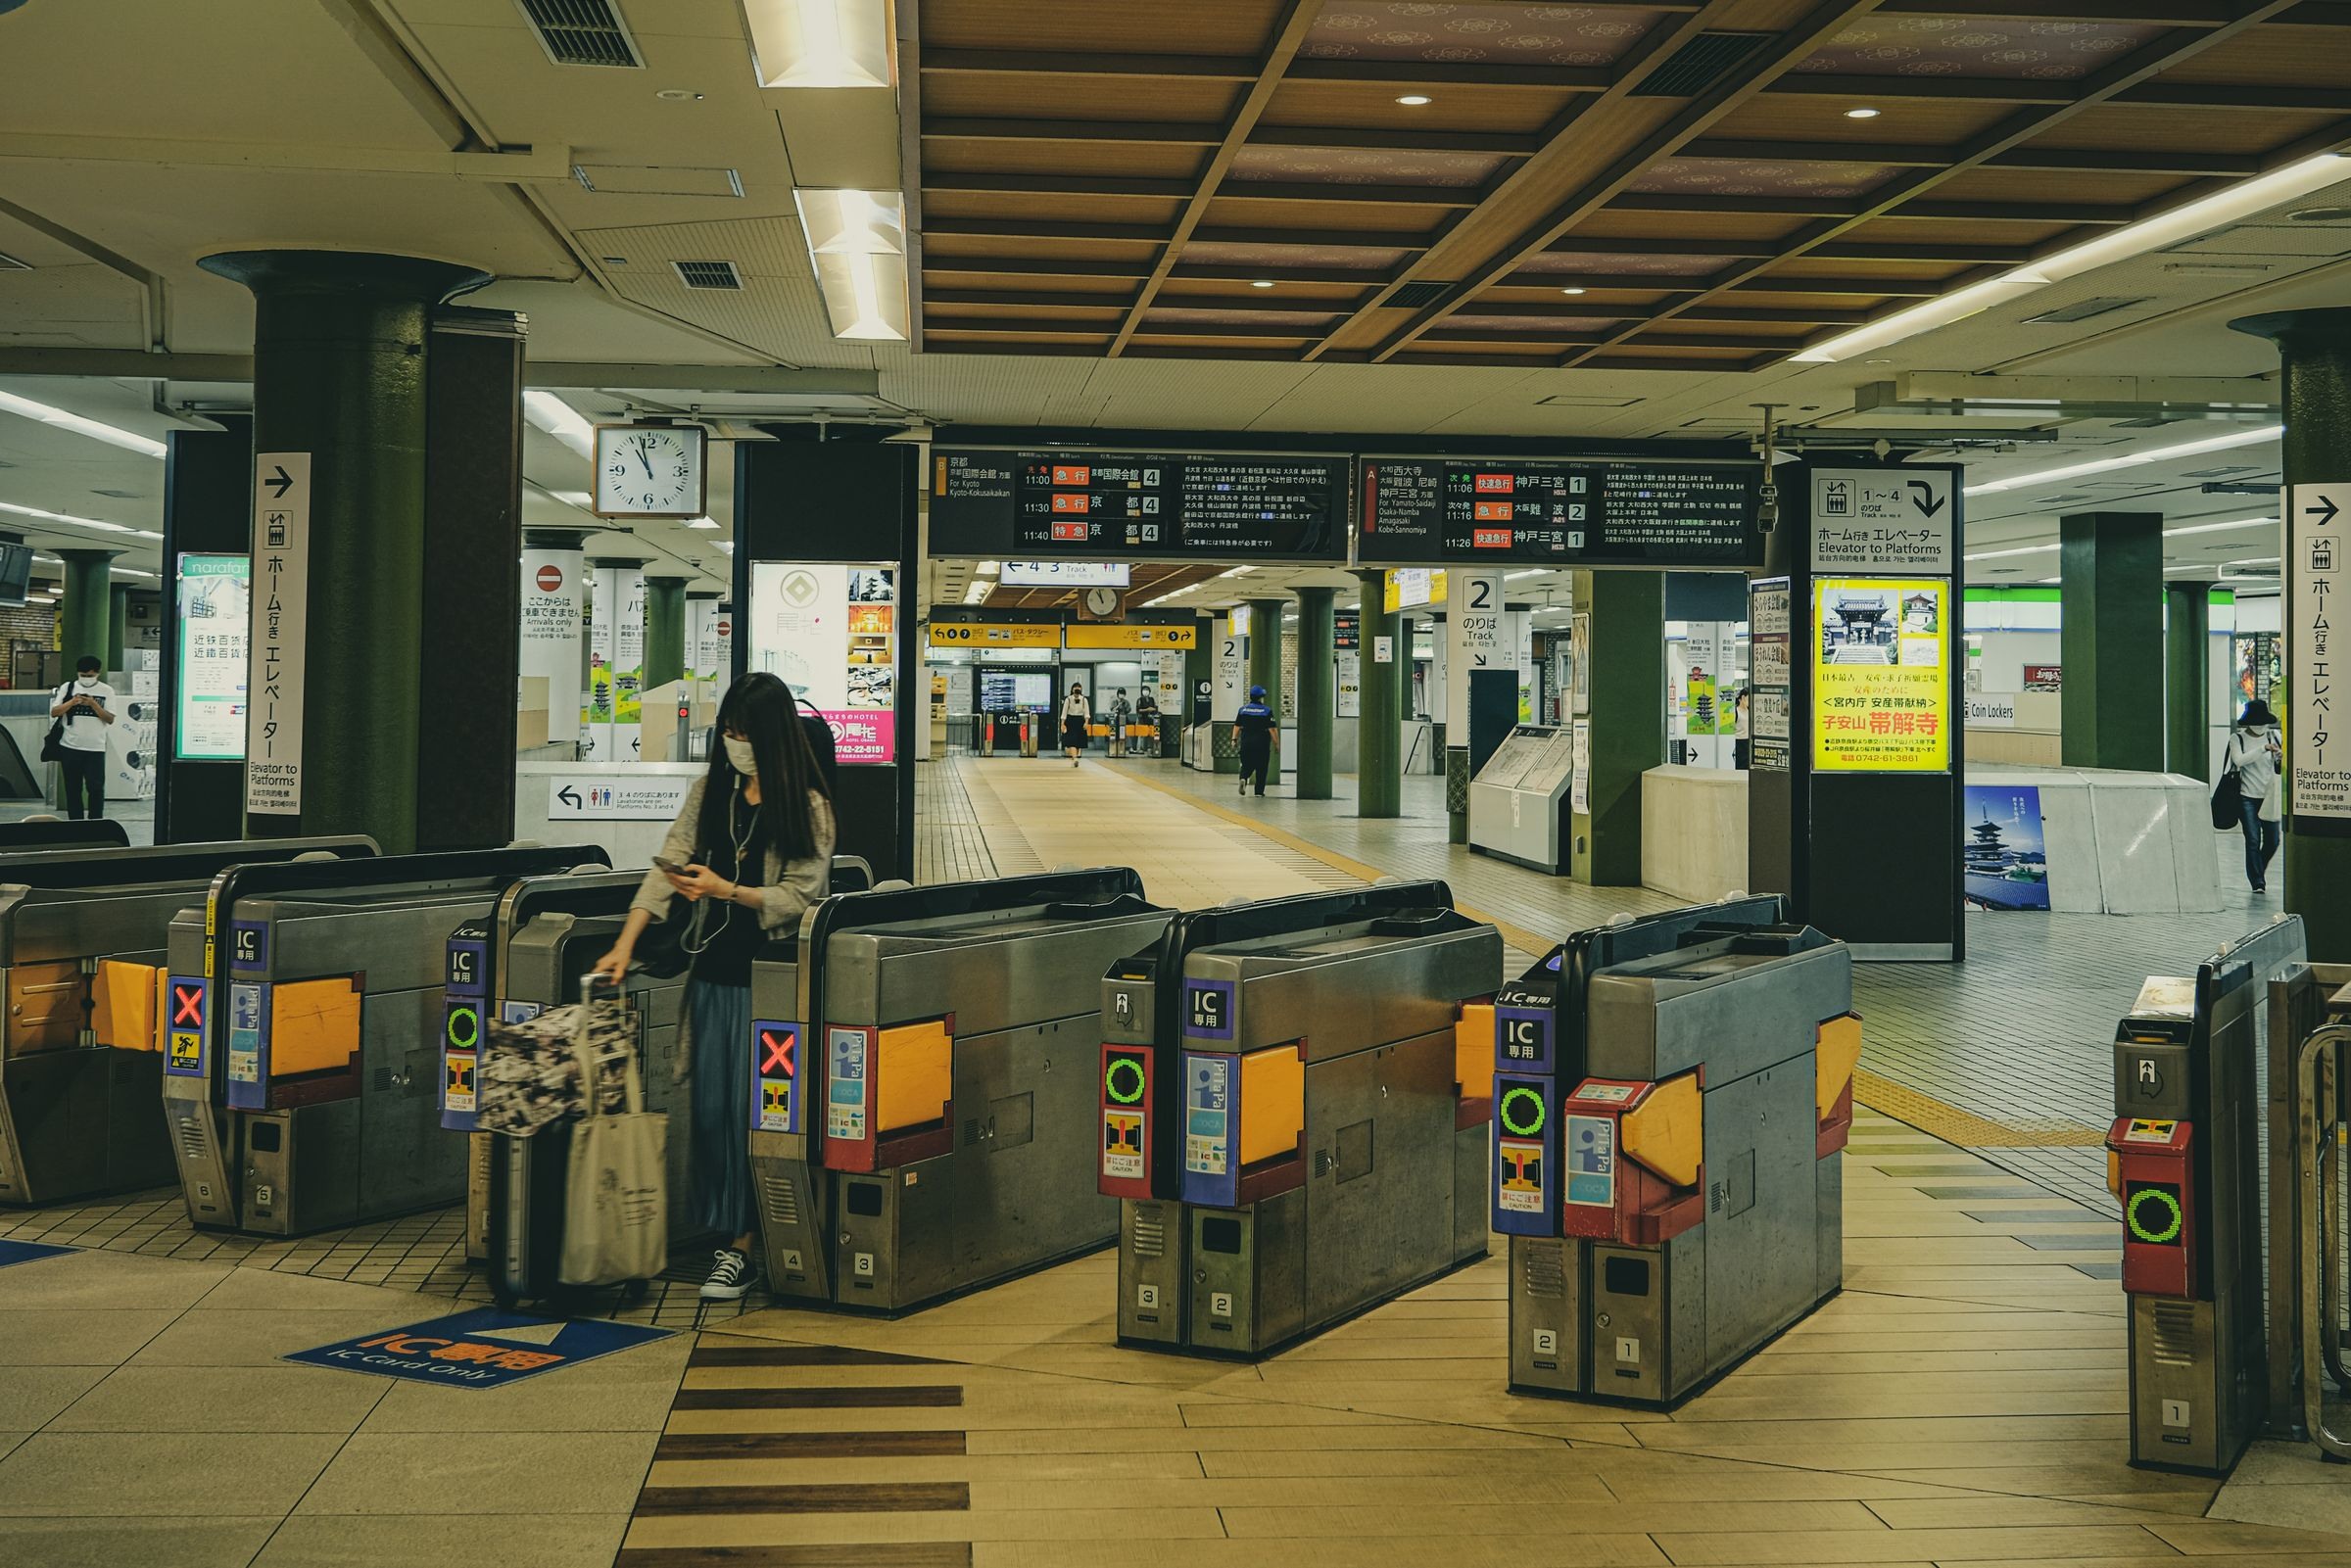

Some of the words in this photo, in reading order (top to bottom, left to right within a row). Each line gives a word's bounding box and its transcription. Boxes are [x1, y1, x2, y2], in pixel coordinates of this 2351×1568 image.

[643, 438, 656, 450] 12
[950, 456, 968, 467] 京都
[615, 465, 626, 476] 9
[673, 466, 683, 477] 3
[1367, 470, 1375, 479] A
[1380, 465, 1422, 476] 大和西大寺
[1026, 475, 1050, 485] 11:00
[1146, 470, 1158, 485] 4
[1515, 476, 1565, 488] 神戸三宮
[962, 480, 980, 489] Kyoto
[1447, 484, 1472, 493] 11:06
[1478, 479, 1510, 489] 快速急行
[644, 493, 653, 504] 6
[1379, 488, 1417, 499] 神戸三宮
[1025, 503, 1049, 512] 11:30
[1146, 499, 1157, 512] 4
[1392, 499, 1436, 509] Yamato-Saidaiji
[1446, 511, 1471, 520] 11:16
[1478, 505, 1510, 517] 急行
[1572, 506, 1582, 518] 2
[1378, 517, 1411, 526] Amagasaki
[1024, 531, 1049, 541] 11:40
[1145, 527, 1156, 540] 4
[1378, 526, 1427, 536] Kobe-Sannomiya
[1513, 530, 1563, 543] 神戸三宮
[1818, 528, 1869, 541] ホーム行き
[1873, 529, 1942, 542] エレベーター
[1445, 539, 1471, 548] 11:26
[1476, 533, 1509, 544] 快速急行
[1819, 543, 1866, 553] Elevator
[1870, 544, 1882, 553] to
[1886, 543, 1942, 554] Platforms
[266, 555, 283, 640] ホーム行き
[1471, 581, 1490, 608] 2
[529, 597, 571, 606] ここからは
[555, 618, 572, 627] only
[2312, 578, 2330, 656] ホーム行き
[1463, 618, 1497, 630] のりば
[1466, 630, 1493, 640] Track
[1223, 641, 1235, 657] 2
[1822, 673, 1855, 683] 日本最古
[264, 647, 280, 759] エレベーター
[1972, 703, 1986, 717] Coin
[1989, 703, 2014, 718] Lockers
[2312, 662, 2329, 765] エレベーター
[1822, 715, 1866, 731] 子安山
[1869, 711, 1939, 736] 帯解寺
[251, 761, 283, 774] Elevator
[285, 765, 298, 774] to
[251, 774, 295, 786] Platforms
[2296, 768, 2335, 780] Elevator
[2339, 771, 2351, 781] to
[2297, 779, 2349, 791] Platforms
[237, 930, 255, 949] IC
[237, 950, 255, 961] 専用
[453, 952, 471, 971] IC
[453, 972, 471, 983] 専用
[1194, 991, 1218, 1013] IC
[1194, 1015, 1218, 1026] 専用
[1509, 1022, 1534, 1044] IC
[851, 1036, 863, 1077] PiTaPa
[1509, 1045, 1534, 1059] 専用
[1213, 1063, 1224, 1109] PiTaPa
[1598, 1122, 1610, 1173] PiTaPa
[200, 1186, 209, 1196] 6
[261, 1190, 268, 1201] 5
[789, 1256, 798, 1266] 4
[860, 1259, 869, 1269] 3
[1144, 1290, 1153, 1303] 3
[1217, 1299, 1226, 1310] 2
[1540, 1335, 1551, 1349] 2
[1625, 1343, 1631, 1357] 1
[326, 1349, 356, 1361] IC
[359, 1352, 431, 1370] Card
[428, 1364, 498, 1381] Only
[2173, 1405, 2179, 1421] 1
